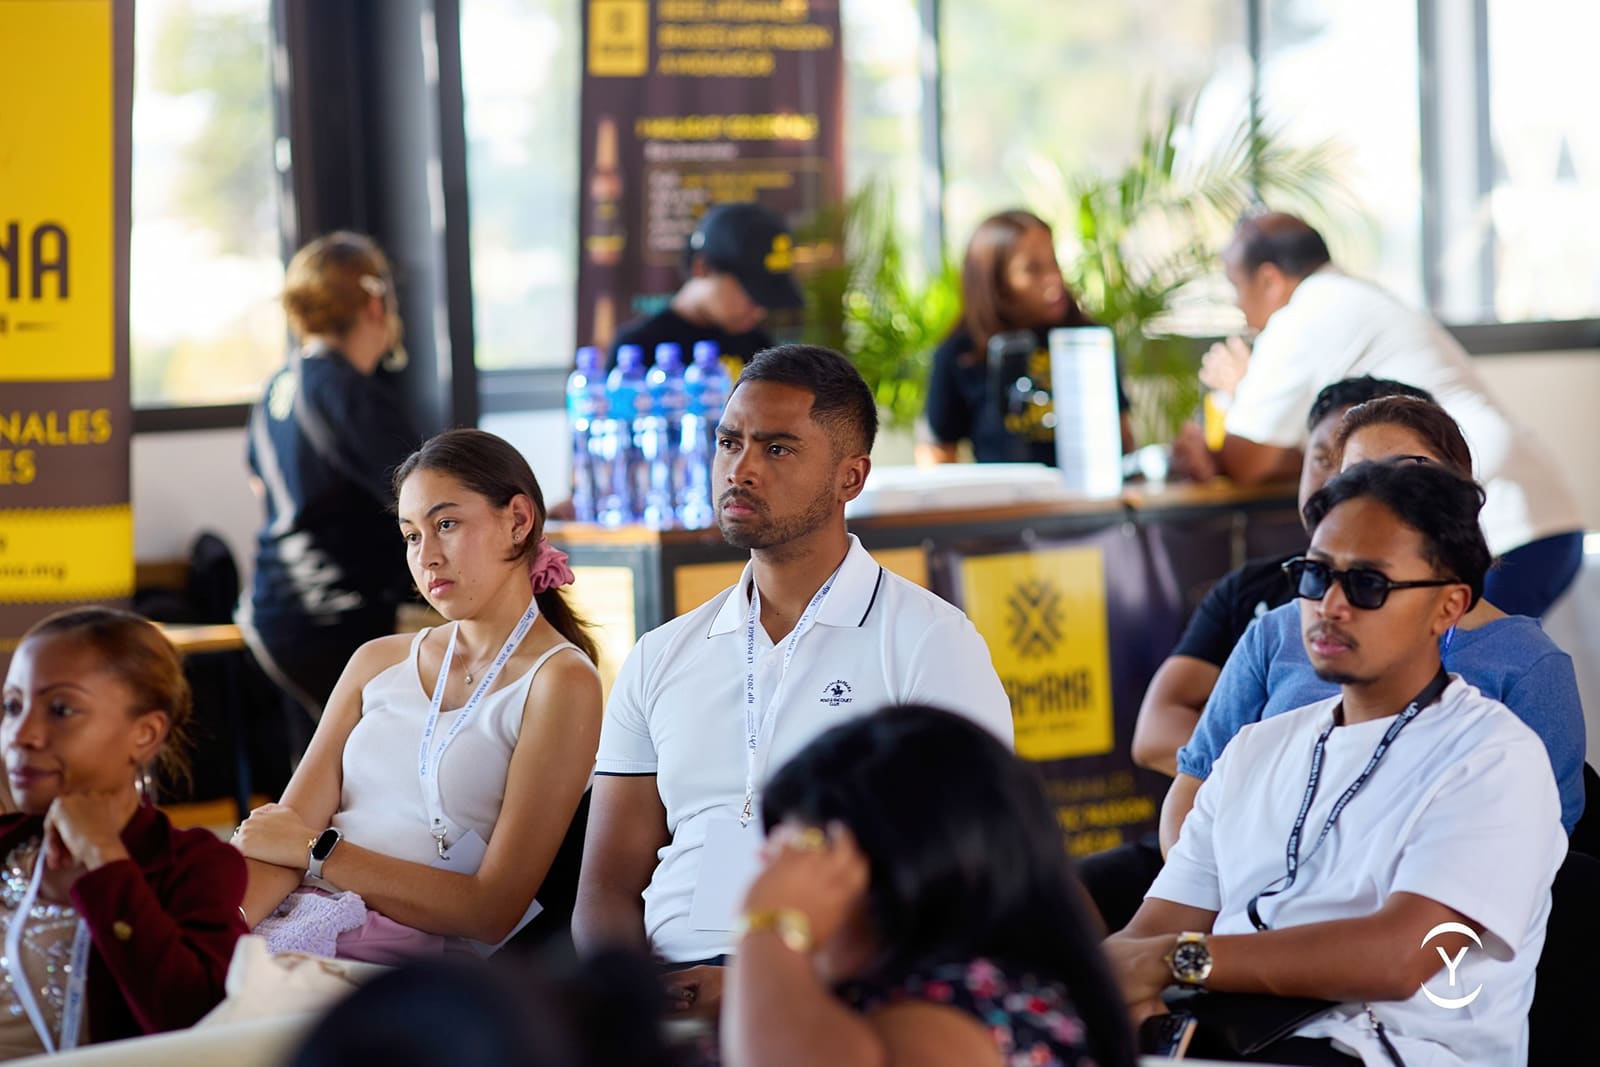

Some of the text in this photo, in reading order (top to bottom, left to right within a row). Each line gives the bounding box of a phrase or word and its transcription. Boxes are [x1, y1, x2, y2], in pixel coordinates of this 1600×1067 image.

[747, 626, 755, 655] PASSAGE
[747, 655, 754, 664] LE
[747, 692, 756, 703] RJP
